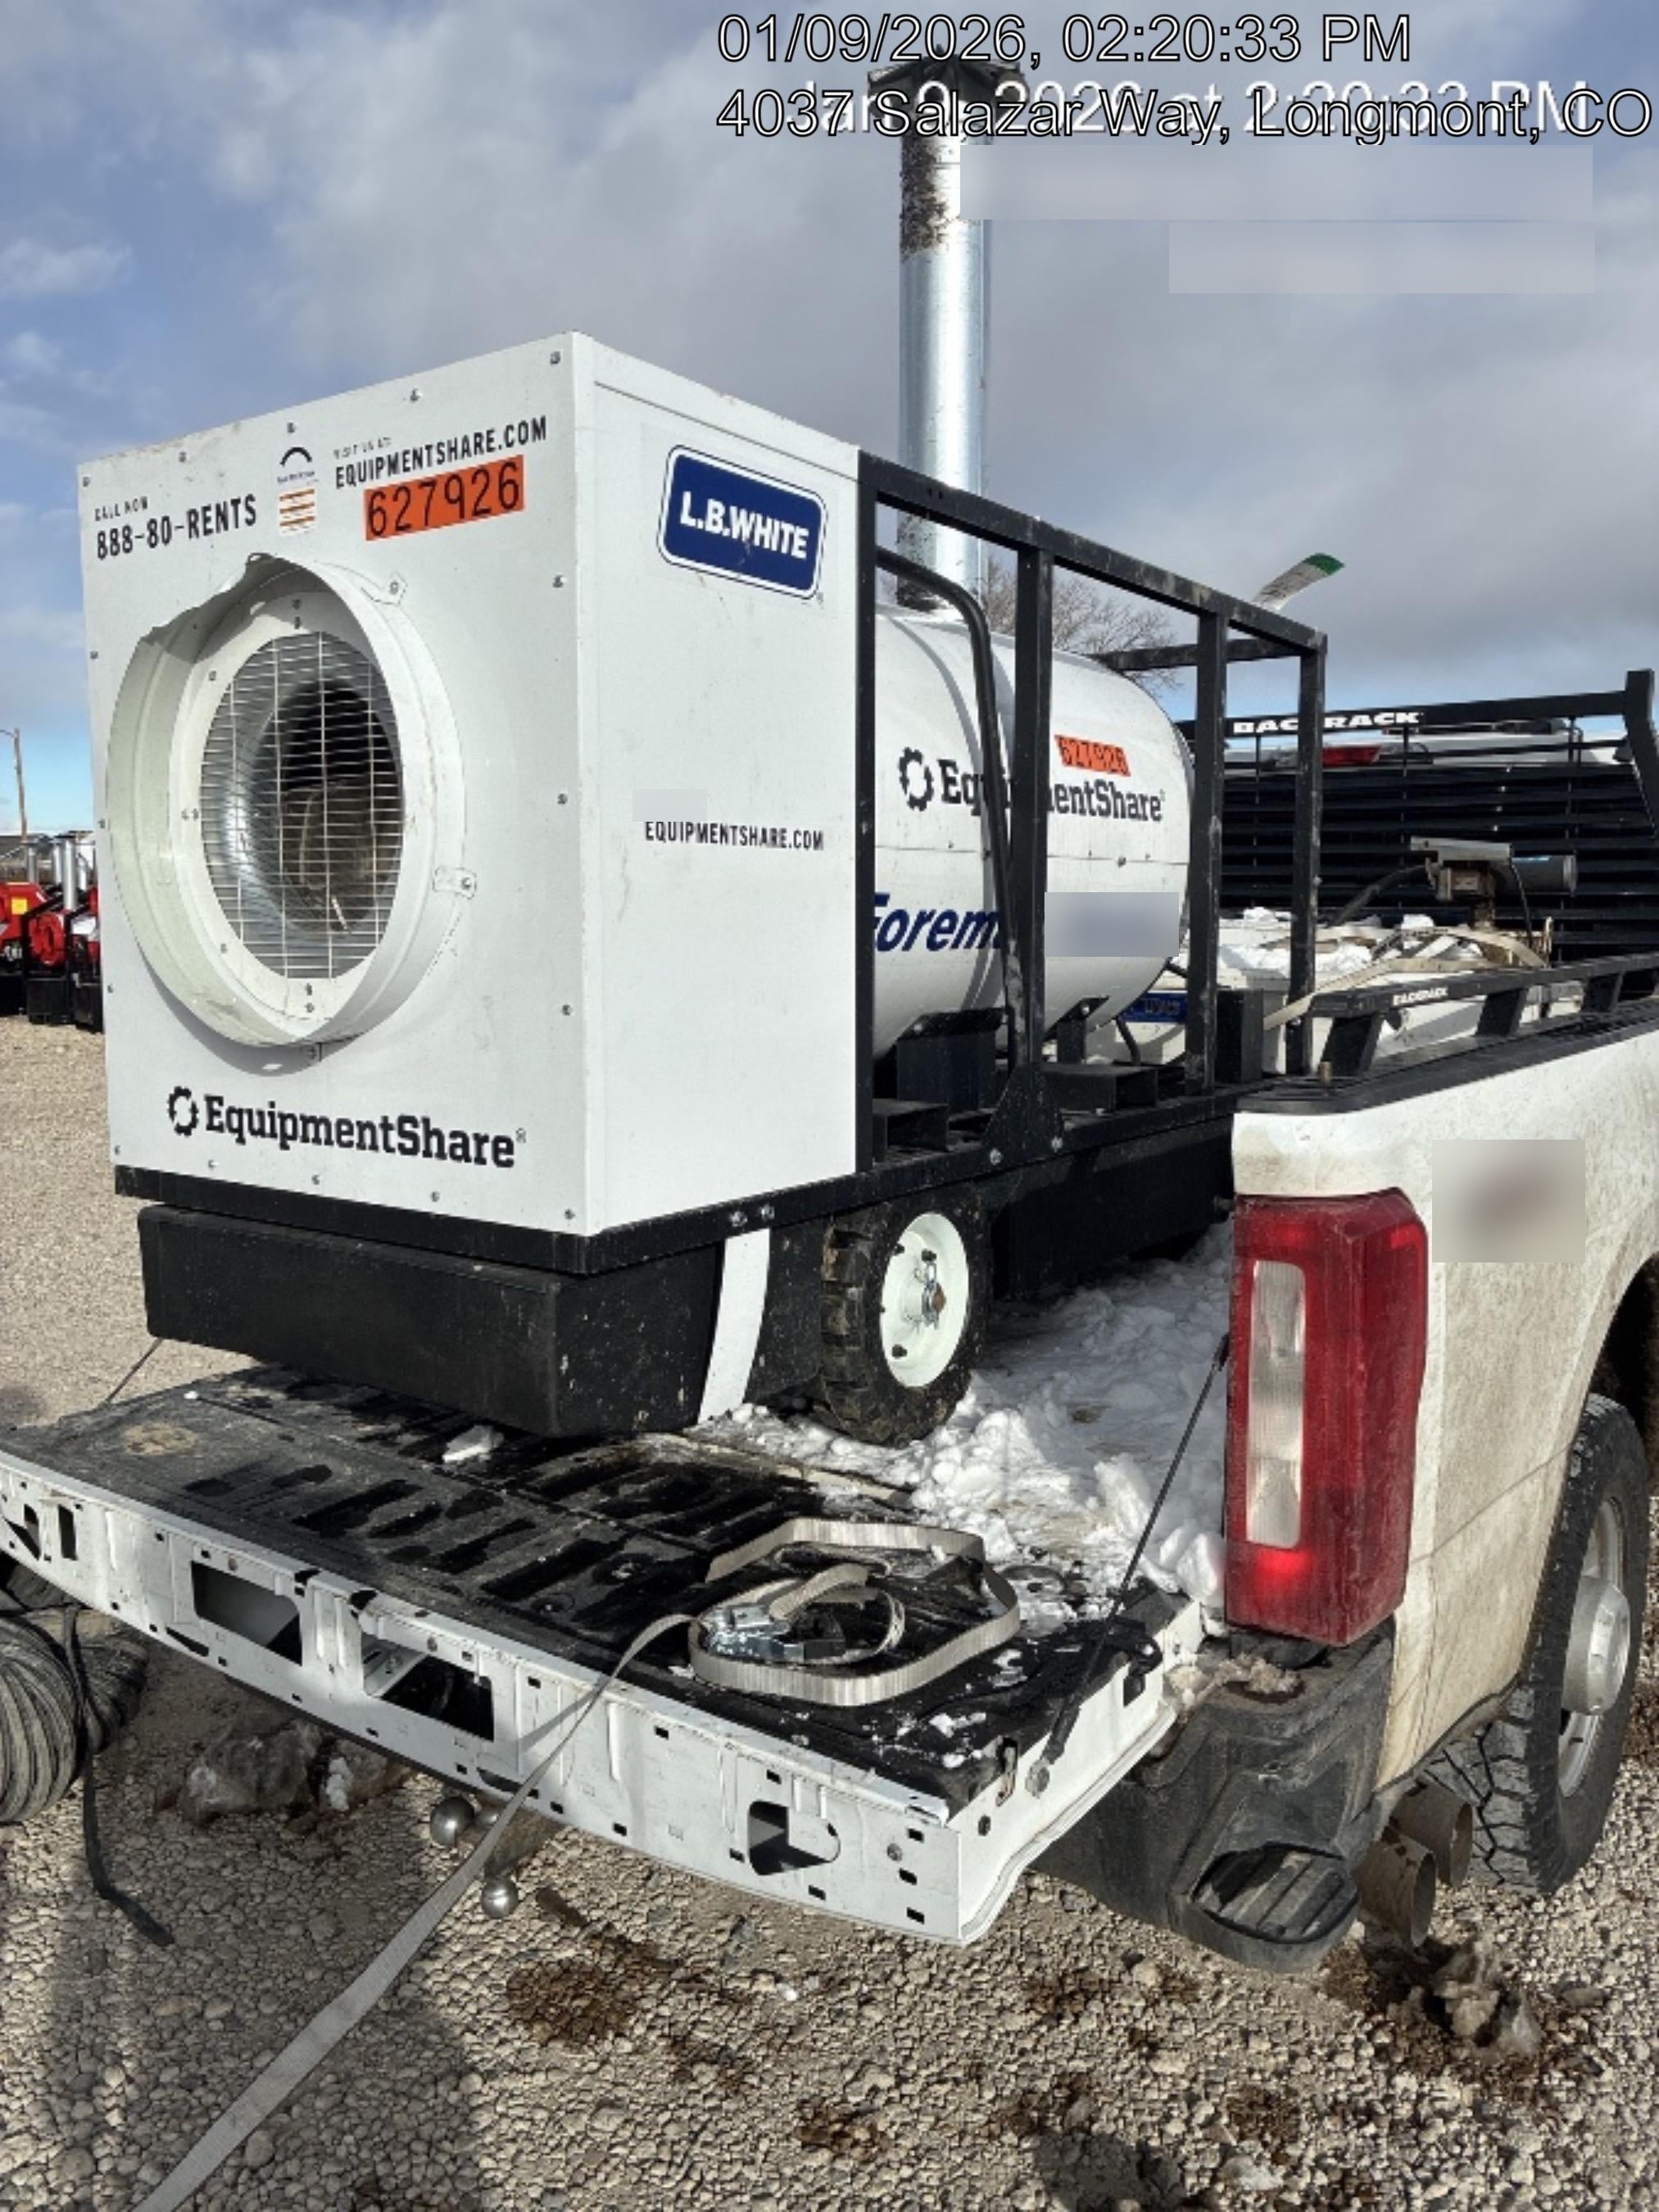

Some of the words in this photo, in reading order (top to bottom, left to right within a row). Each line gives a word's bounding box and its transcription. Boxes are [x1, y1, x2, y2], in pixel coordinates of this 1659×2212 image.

[336, 415, 546, 489] EQUIPMENTSHARE.COM
[97, 493, 257, 560] 888-80-RENTS
[369, 462, 519, 537] 627926
[1233, 711, 1420, 734] BACRACK
[645, 821, 823, 850] EQUIPMENTSHARE.COM
